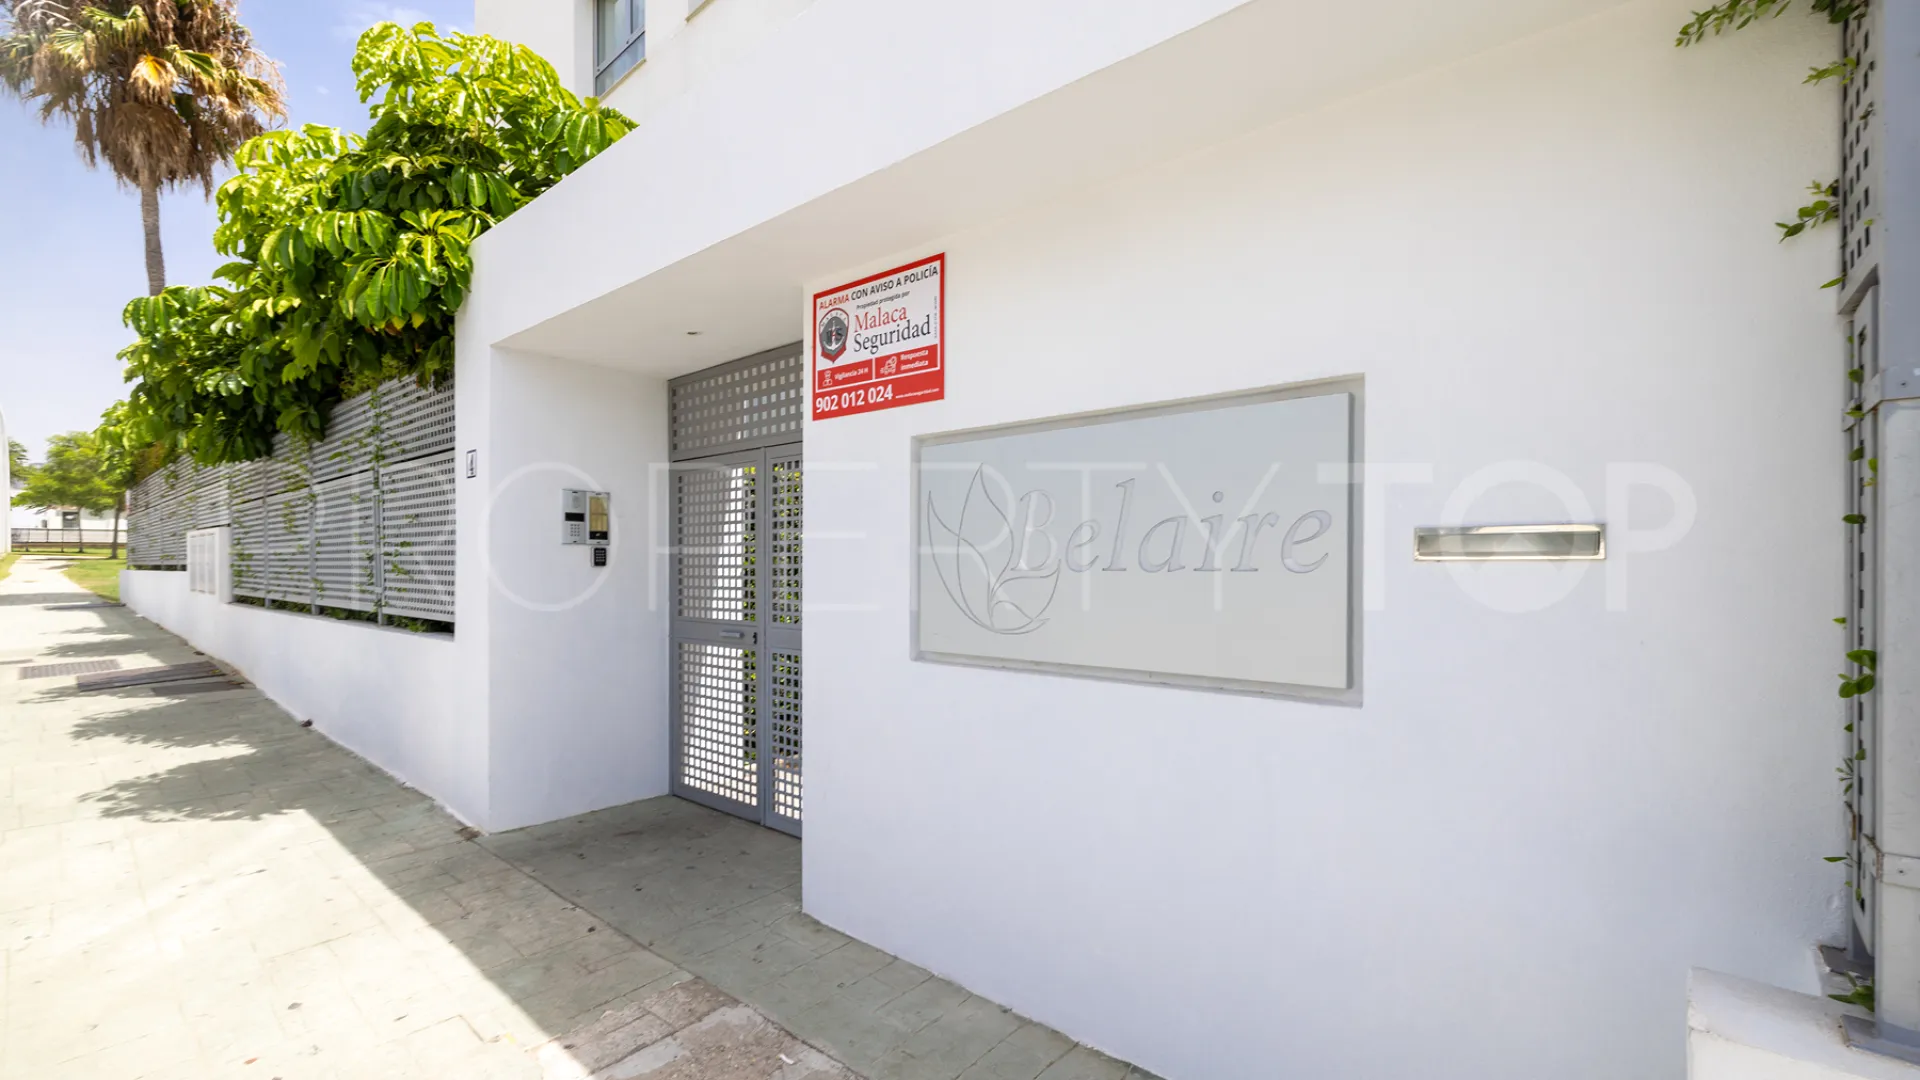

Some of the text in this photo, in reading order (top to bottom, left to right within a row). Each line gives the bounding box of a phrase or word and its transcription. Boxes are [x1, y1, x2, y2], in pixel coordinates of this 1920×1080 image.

[819, 266, 938, 310] ALARMA CON AVISO A POLICÍA
[854, 306, 908, 333] Malaca
[854, 314, 931, 354] Seguridad
[816, 394, 839, 413] 902
[841, 389, 865, 408] 012
[868, 384, 893, 404] 024
[1010, 477, 1333, 574] Belaire
